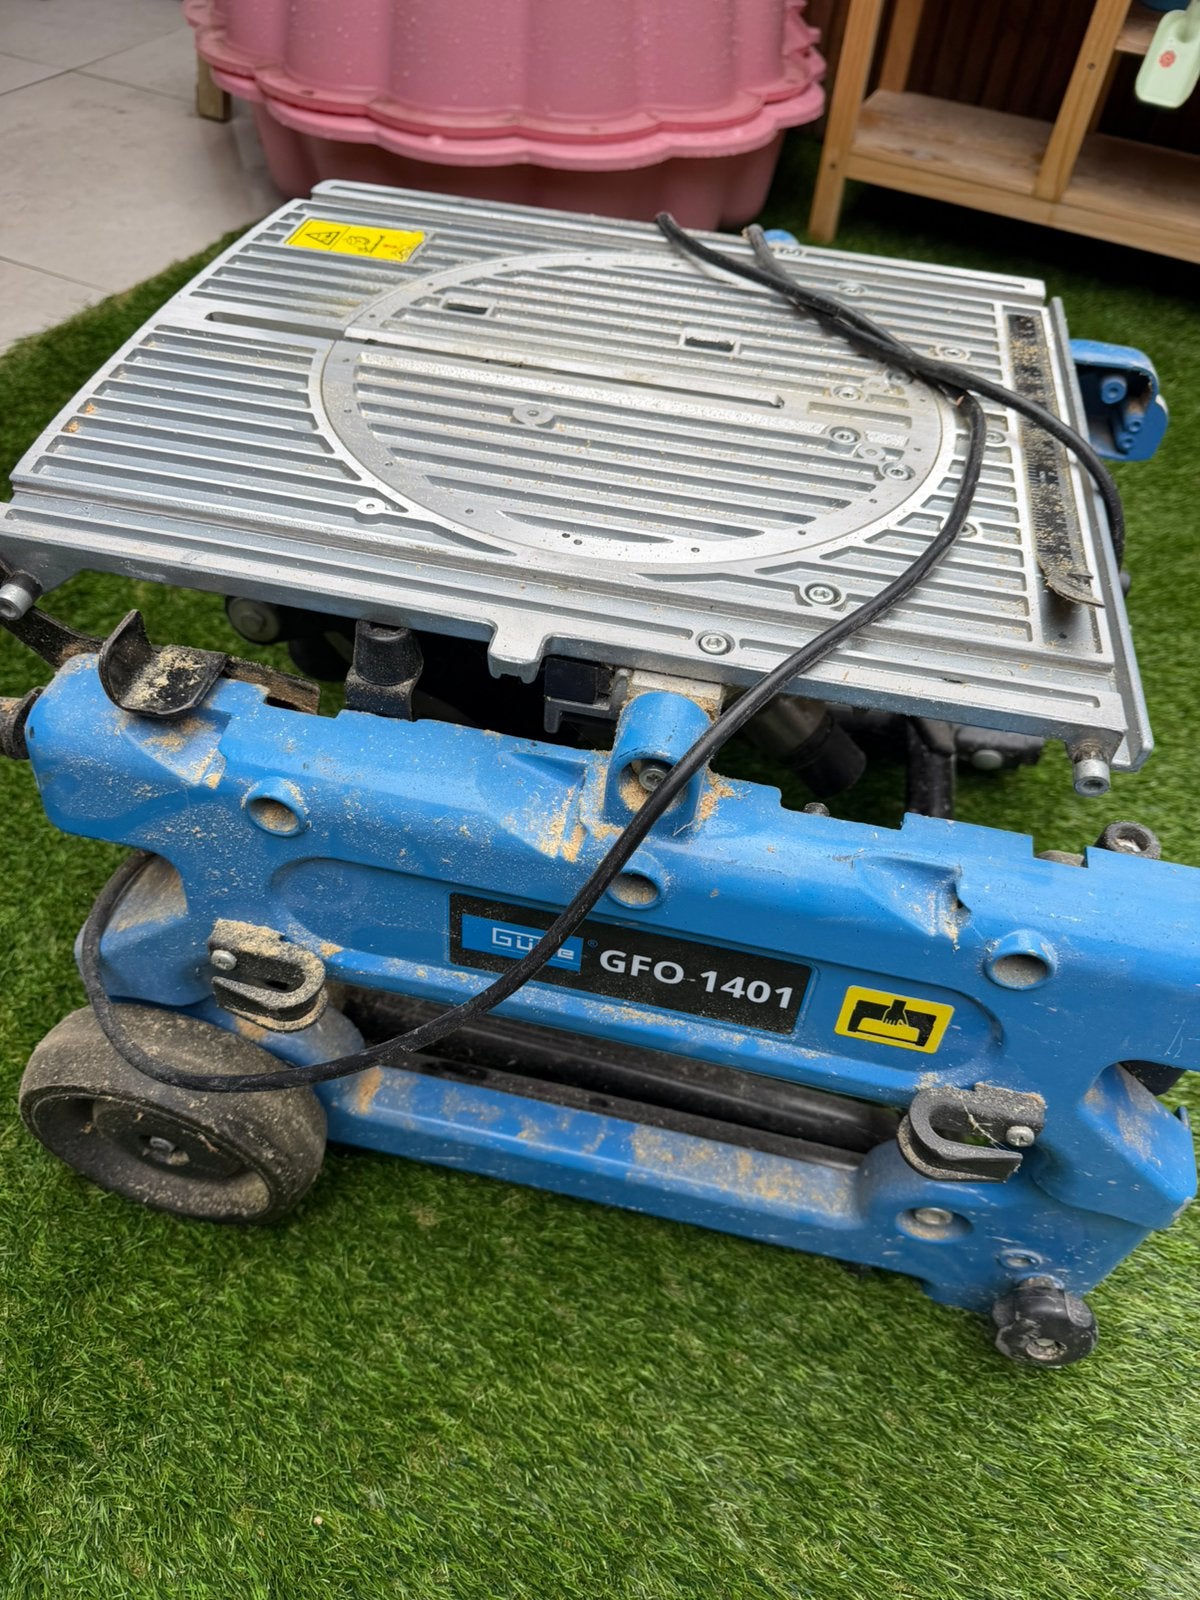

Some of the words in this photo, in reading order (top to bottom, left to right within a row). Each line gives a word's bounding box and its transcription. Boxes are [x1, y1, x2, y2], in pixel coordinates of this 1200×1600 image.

[492, 927, 574, 960] Güe
[599, 949, 684, 985] GFO
[699, 970, 794, 1009] 1401
